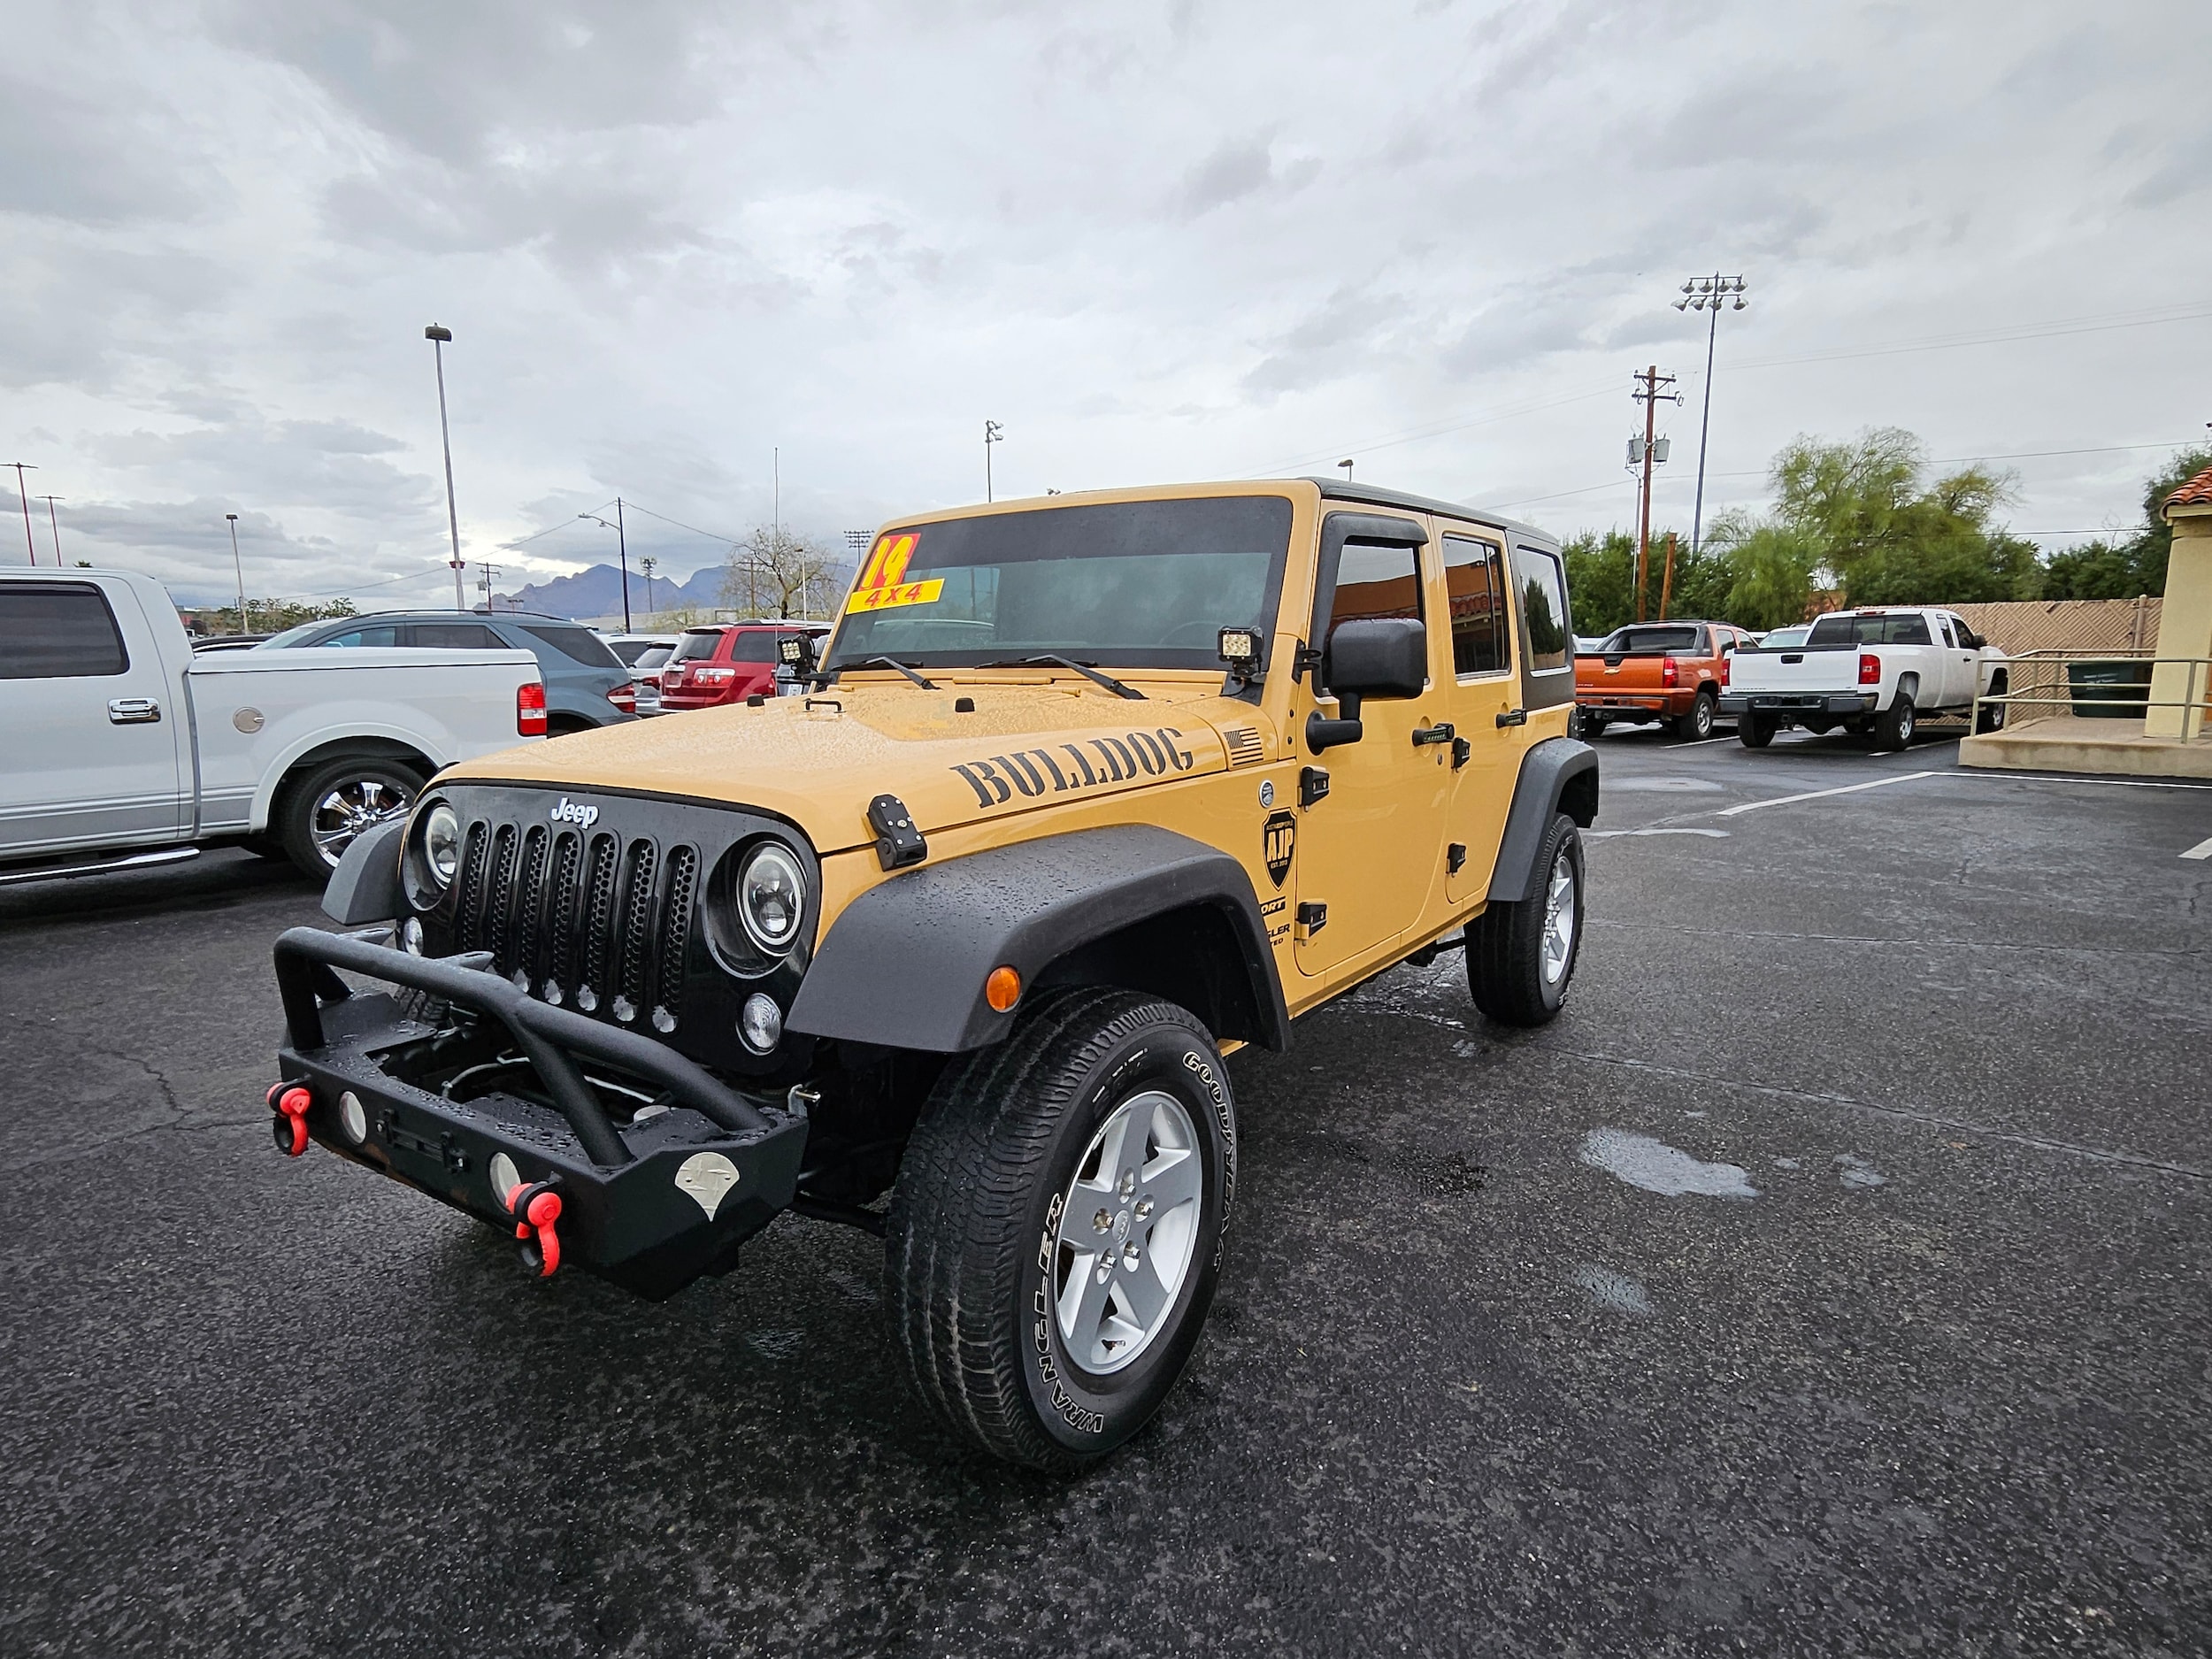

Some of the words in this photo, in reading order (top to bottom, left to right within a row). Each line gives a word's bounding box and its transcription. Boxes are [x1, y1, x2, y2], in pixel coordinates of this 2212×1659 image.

[860, 536, 914, 589] 14
[949, 727, 1194, 809] BULLDOG
[551, 797, 599, 830] Jeep
[1267, 828, 1294, 863] AJP
[1183, 1051, 1234, 1271] GOODYEAR
[1034, 1193, 1104, 1433] WRANGLER
